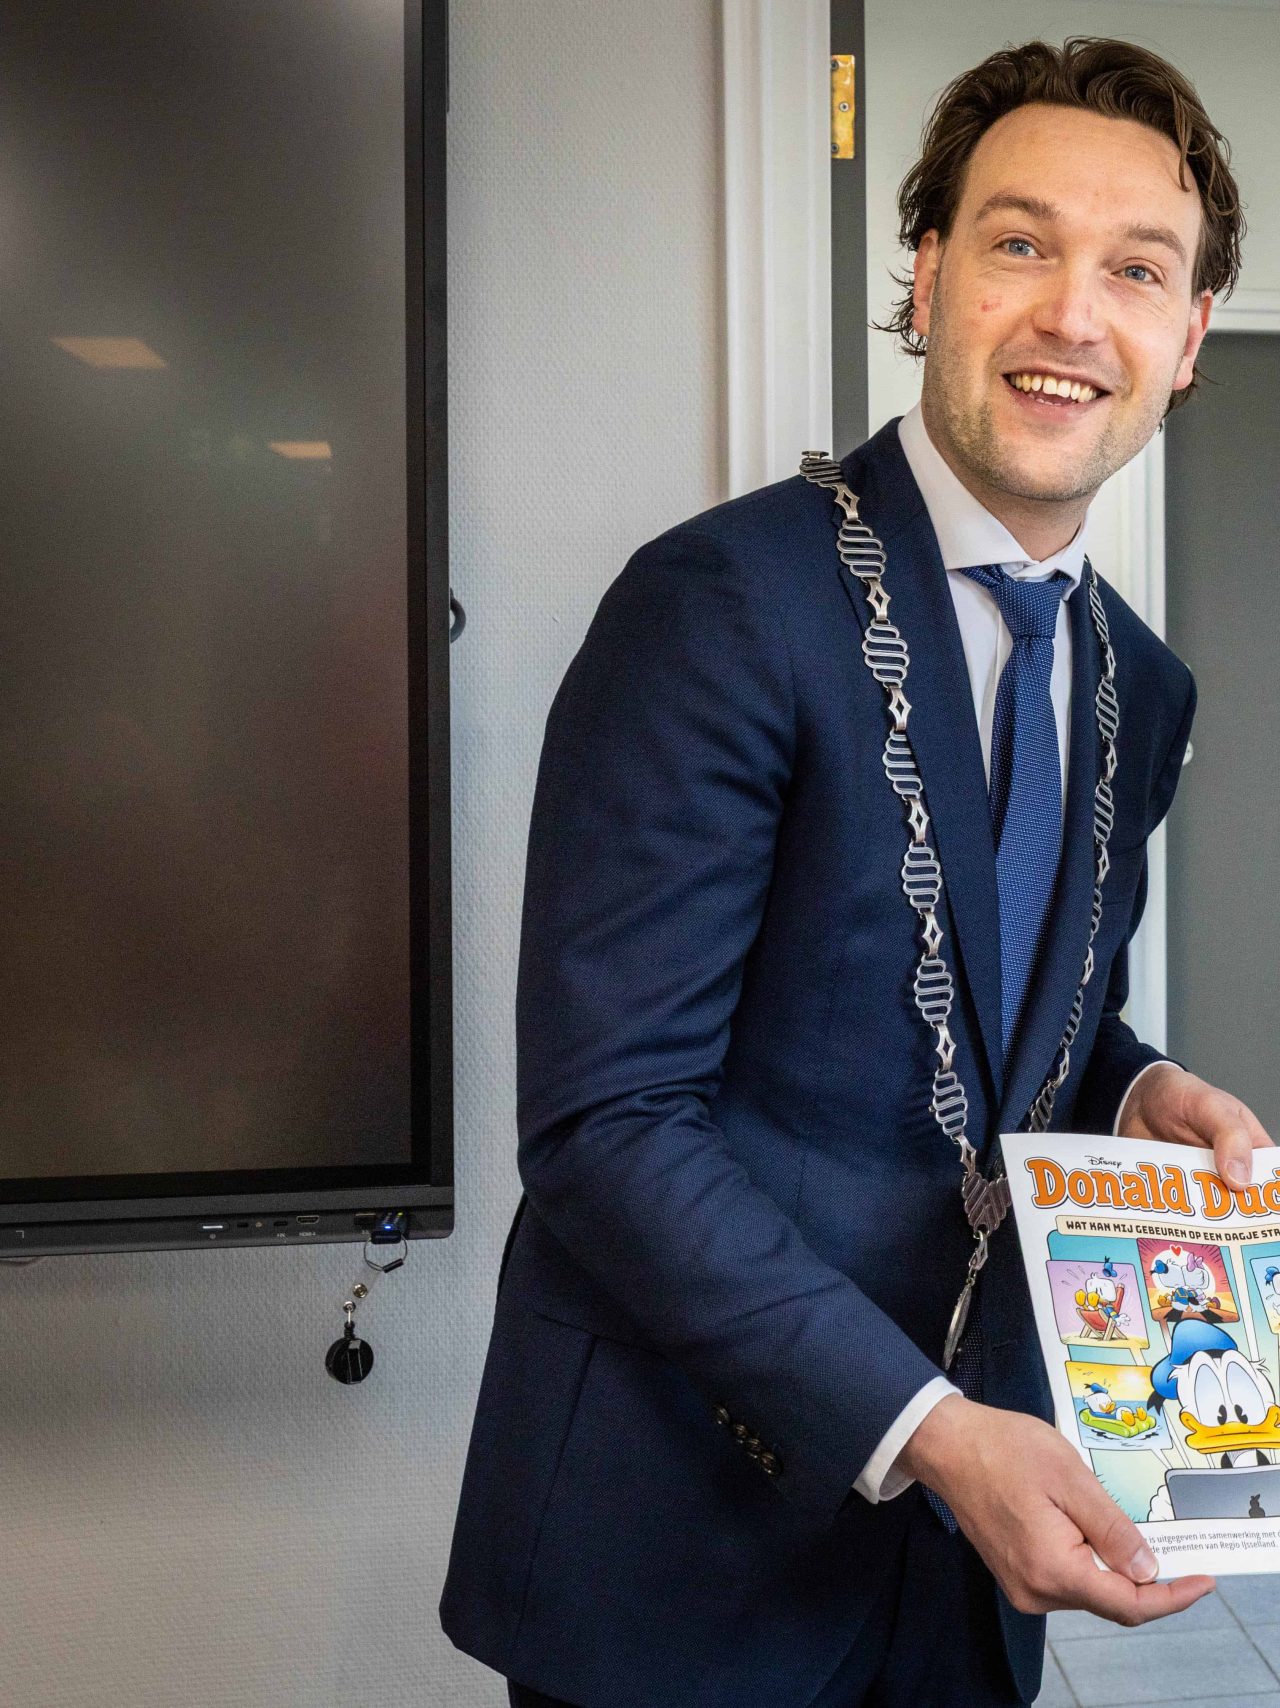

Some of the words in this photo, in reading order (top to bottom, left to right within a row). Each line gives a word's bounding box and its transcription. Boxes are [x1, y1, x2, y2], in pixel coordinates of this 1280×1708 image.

[1025, 1157, 1195, 1216] Donald
[1066, 1221, 1087, 1230] WAT
[1090, 1222, 1111, 1231] KAN
[1113, 1223, 1133, 1233] MIJ
[1136, 1225, 1187, 1238] GEBEUREN
[1189, 1230, 1201, 1239] OP
[1203, 1232, 1221, 1241] EEN
[1225, 1231, 1259, 1241] DAGJE
[1157, 1534, 1198, 1545] uitgegeven
[1207, 1531, 1261, 1541] samenwerking
[1262, 1531, 1276, 1539] met
[1162, 1544, 1203, 1554] gemeenten
[1205, 1542, 1219, 1550] van
[1220, 1541, 1240, 1551] Regio
